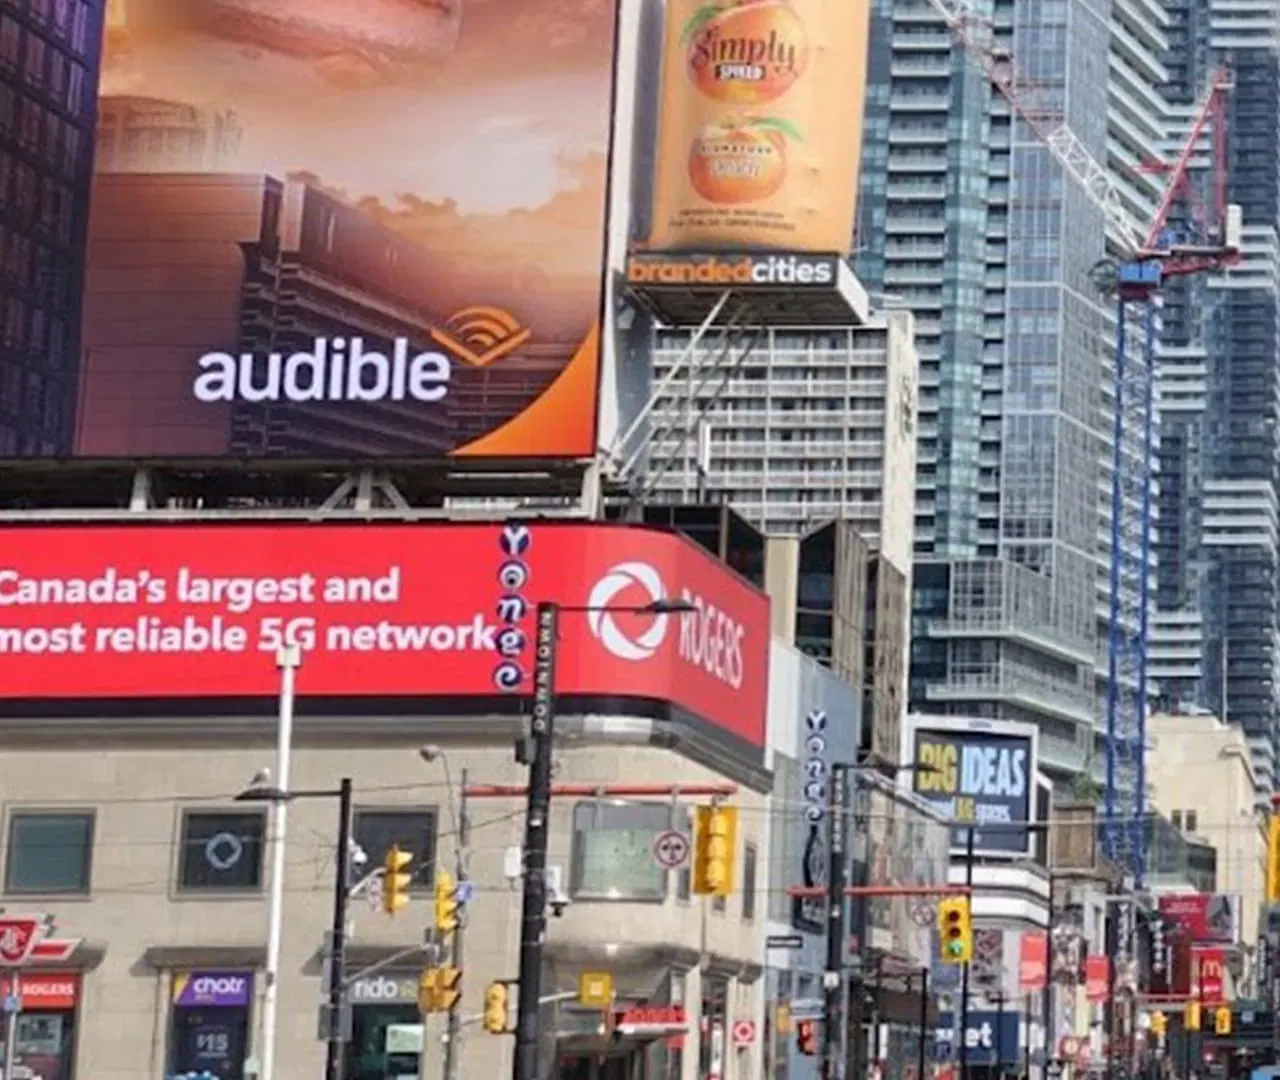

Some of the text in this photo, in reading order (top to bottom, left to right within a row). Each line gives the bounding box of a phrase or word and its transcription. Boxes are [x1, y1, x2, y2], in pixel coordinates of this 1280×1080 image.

[194, 337, 451, 402] audible
[0, 566, 400, 613] Canada's largest and
[95, 616, 248, 653] reliable
[257, 617, 316, 651] 5G
[326, 613, 497, 652] network
[960, 746, 1027, 797] IDEAS
